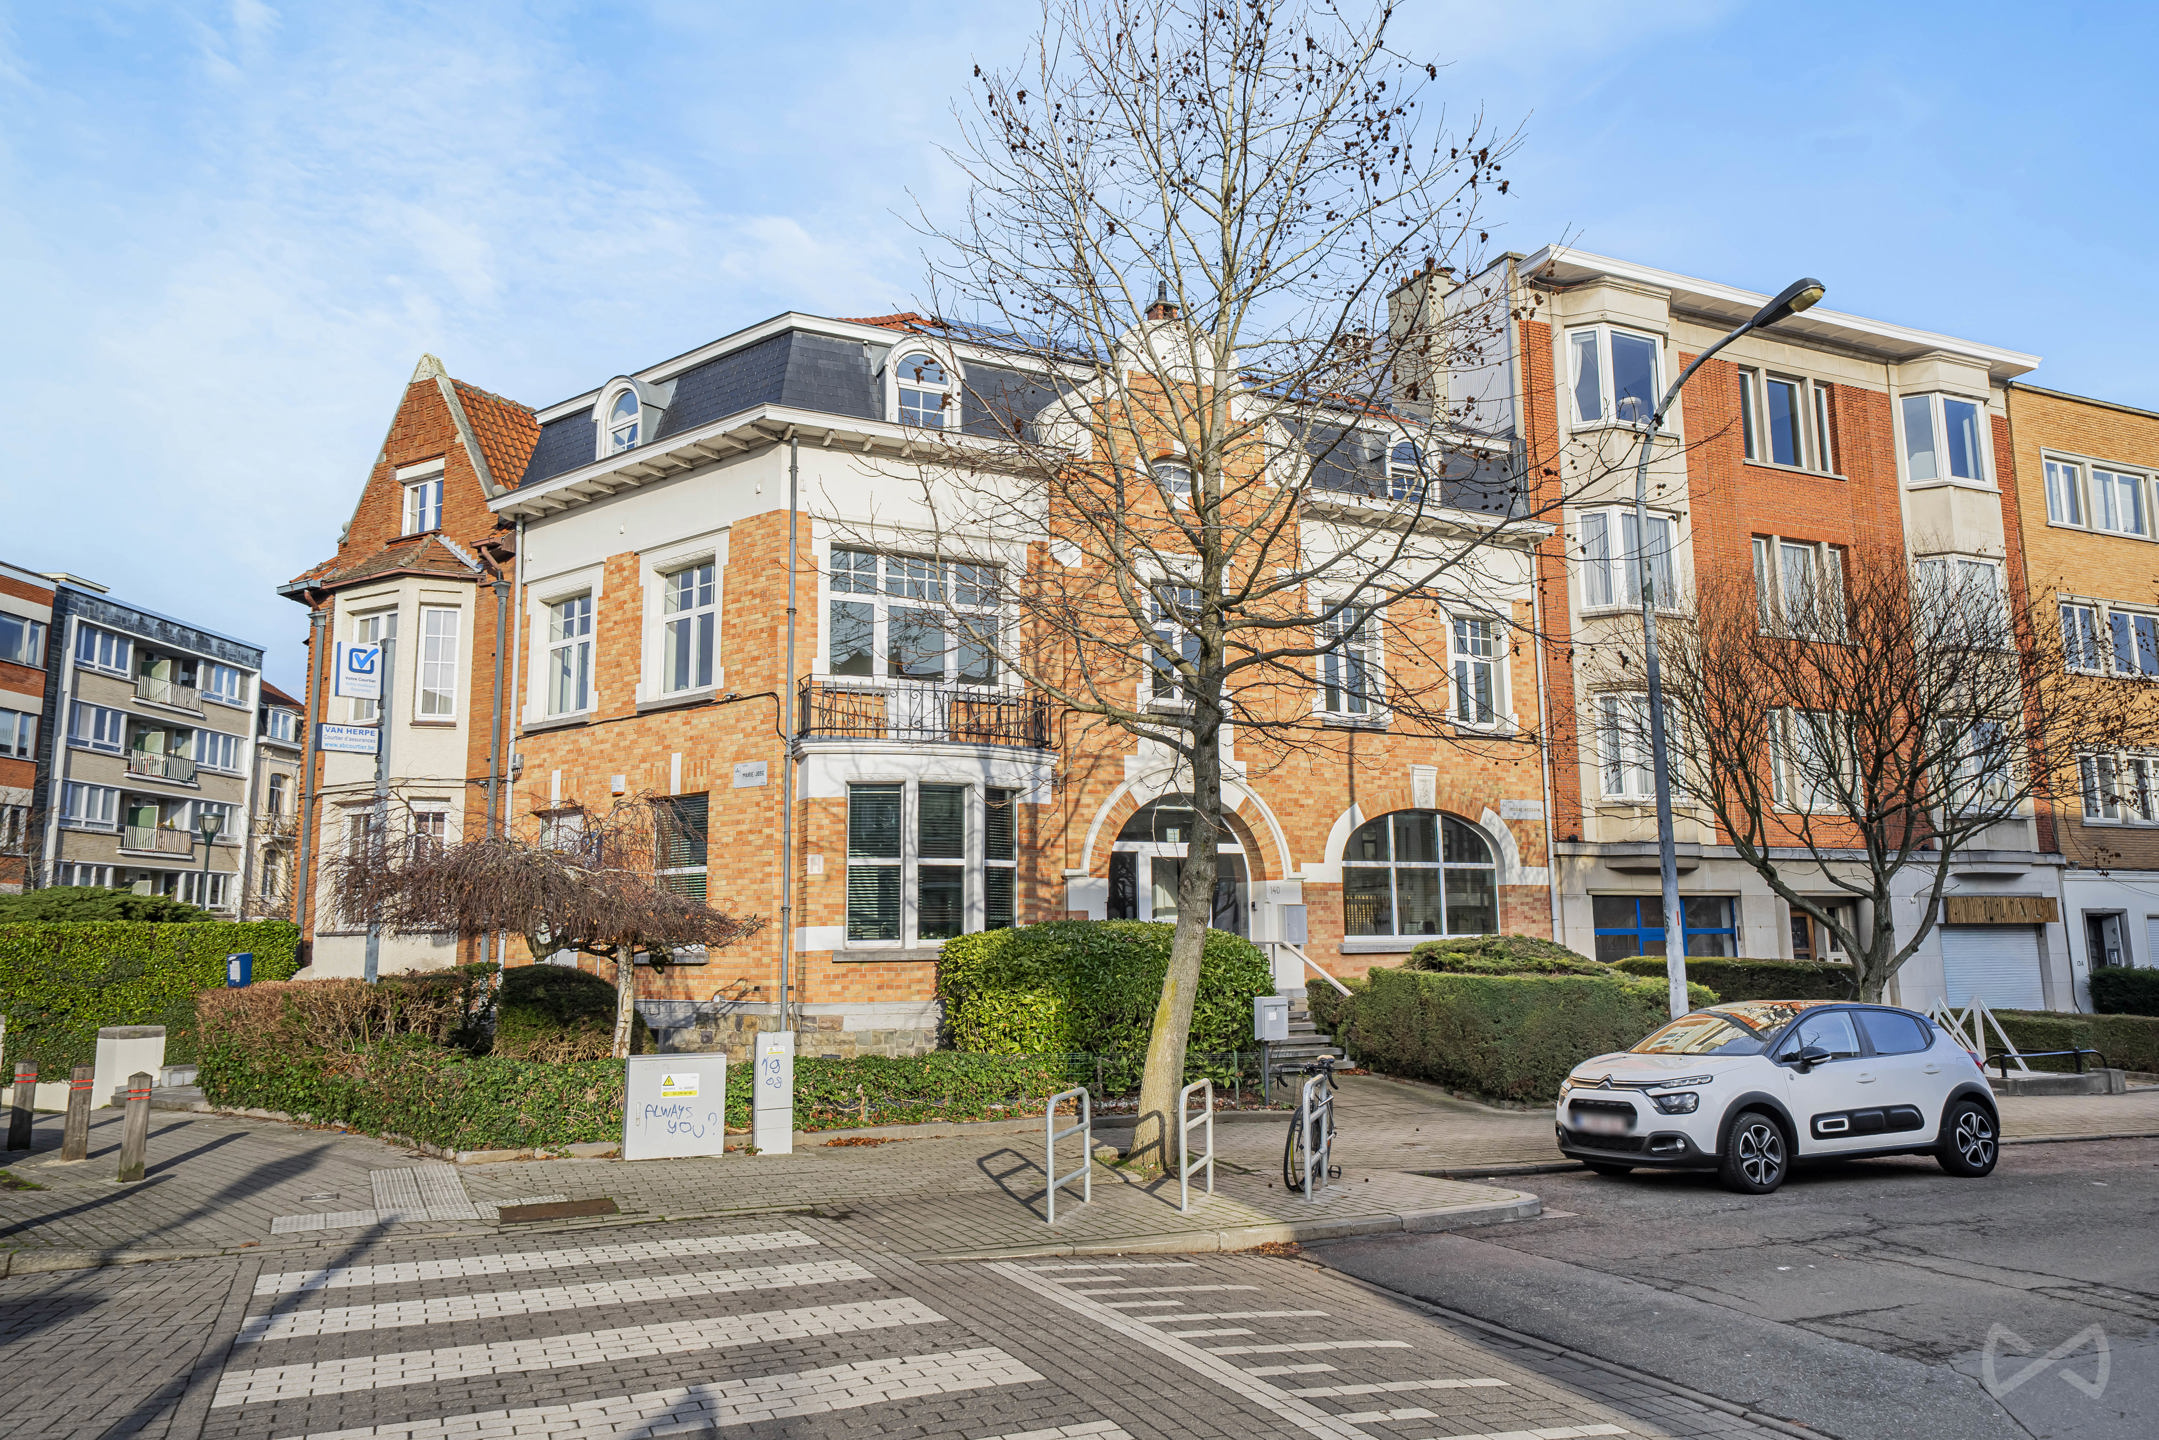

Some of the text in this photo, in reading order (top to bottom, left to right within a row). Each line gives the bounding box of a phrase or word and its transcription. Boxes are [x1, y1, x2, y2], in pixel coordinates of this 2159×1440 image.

[346, 728, 376, 737] HERPE
[1270, 886, 1280, 895] 140
[645, 1104, 693, 1126] ALWAYS
